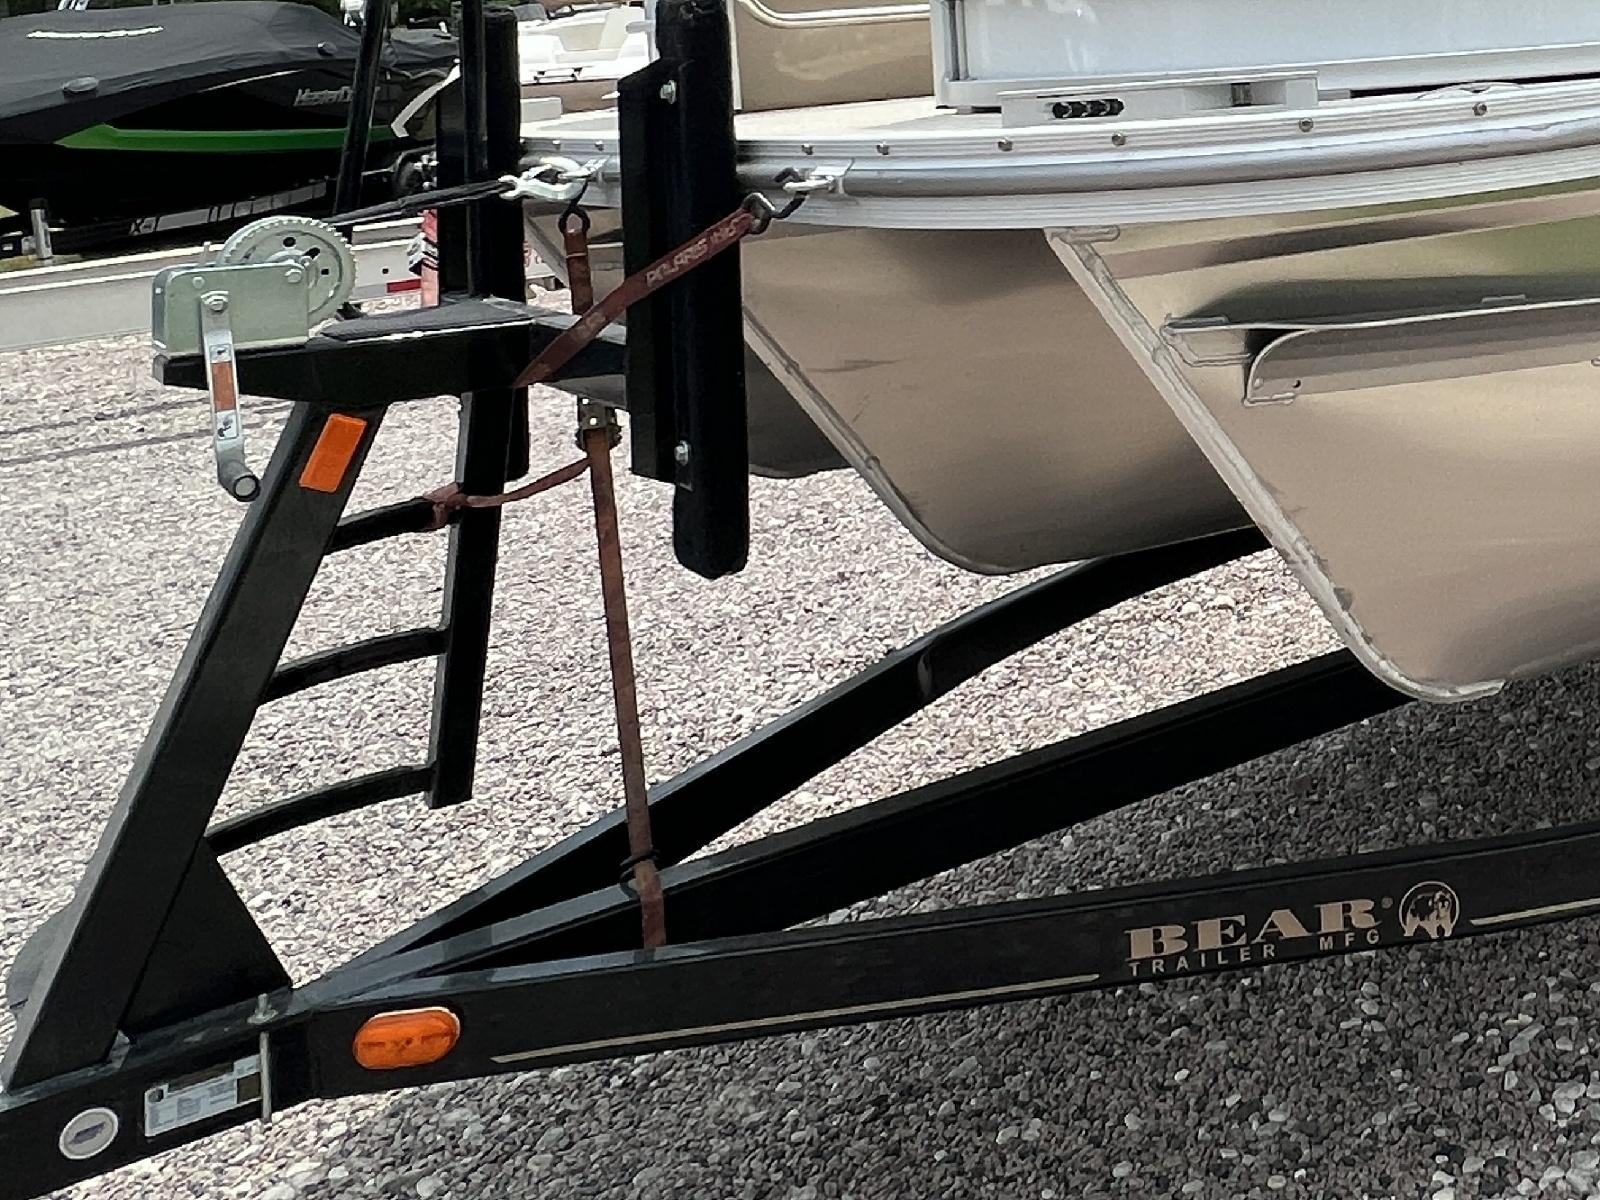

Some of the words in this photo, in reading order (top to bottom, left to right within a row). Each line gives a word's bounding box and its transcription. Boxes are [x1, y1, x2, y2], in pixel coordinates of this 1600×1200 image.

[1124, 899, 1382, 961] BEAR
[1128, 944, 1276, 977] TRAILER
[1319, 928, 1380, 952] MFG
